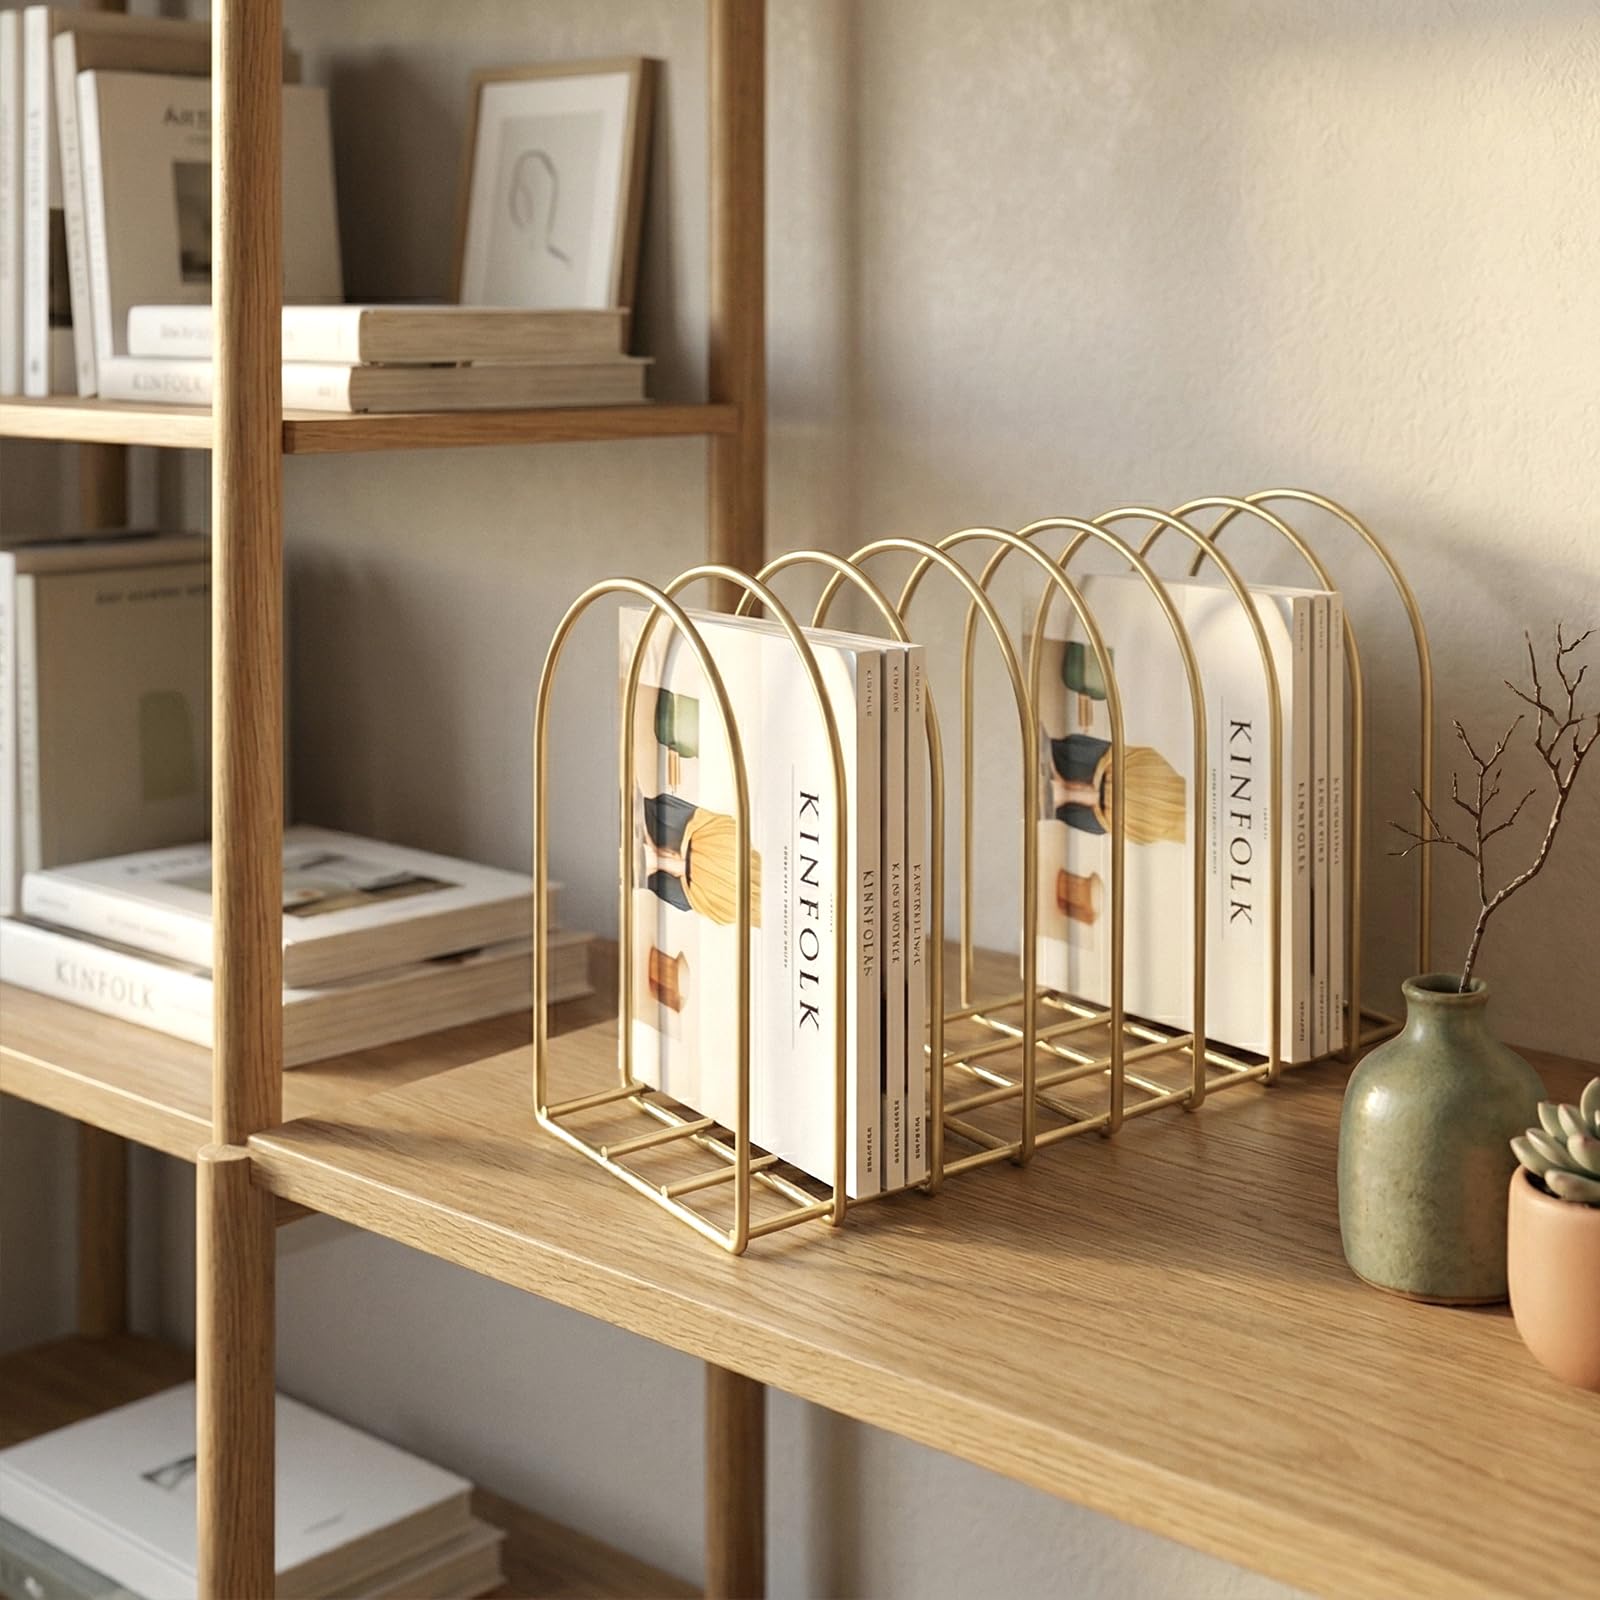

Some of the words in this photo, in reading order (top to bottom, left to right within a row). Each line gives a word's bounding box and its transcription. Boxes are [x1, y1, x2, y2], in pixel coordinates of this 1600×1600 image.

[799, 790, 820, 1032] KINFOLK
[1229, 719, 1253, 926] KINFOLK
[55, 957, 155, 1012] KINFOLK
